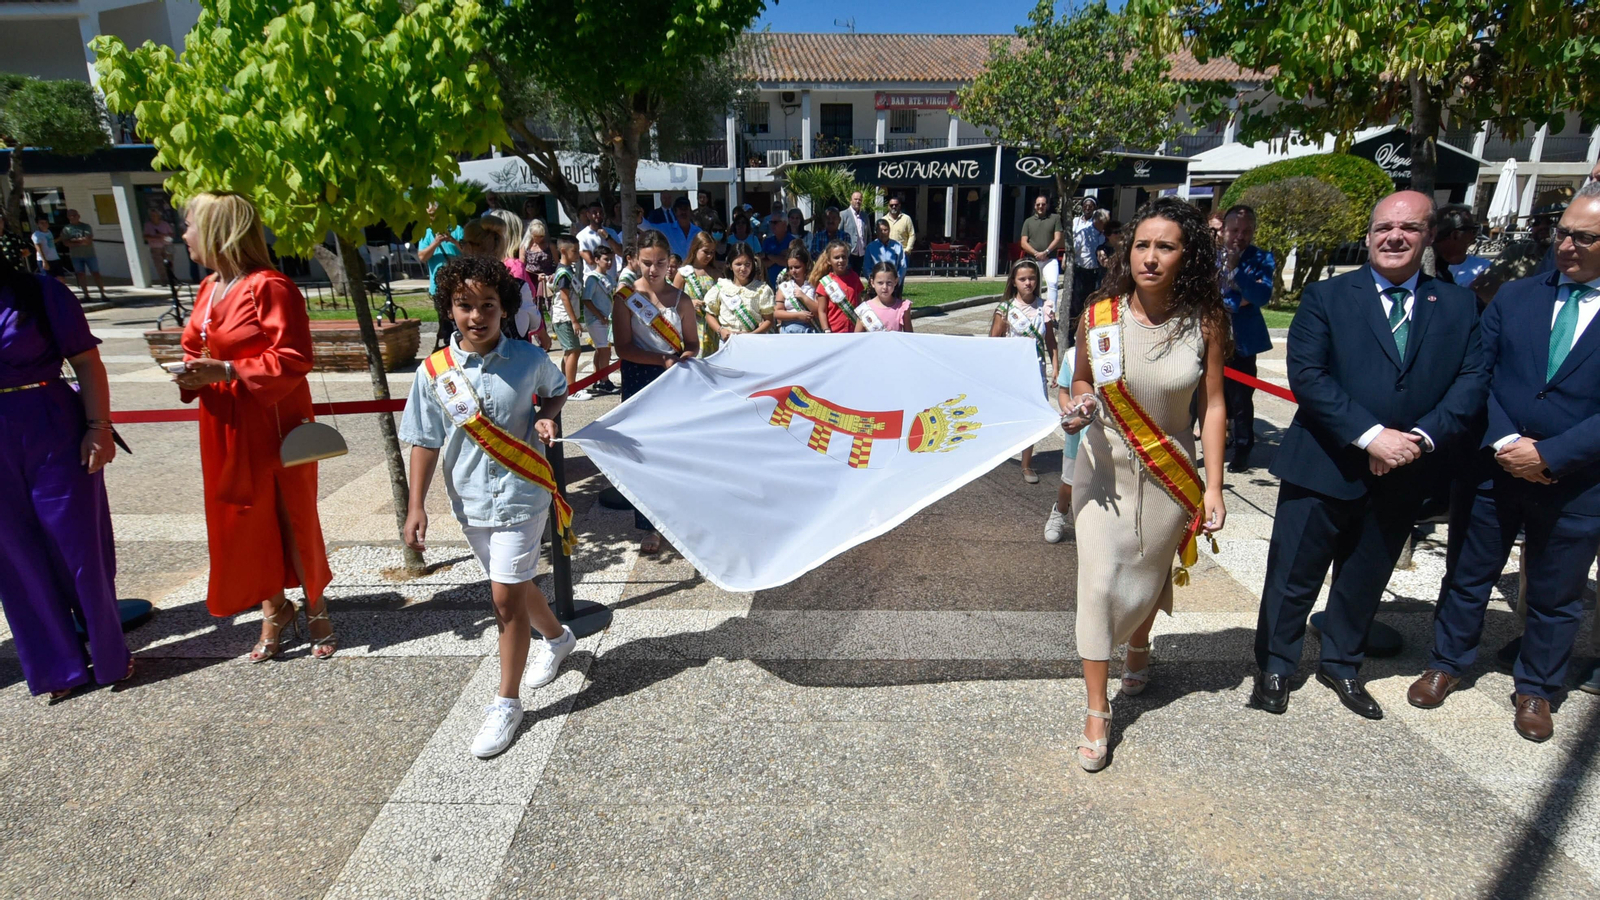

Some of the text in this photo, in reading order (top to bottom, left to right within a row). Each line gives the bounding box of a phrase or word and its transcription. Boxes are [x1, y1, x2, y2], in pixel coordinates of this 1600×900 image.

[891, 96, 905, 105] BAR
[925, 96, 948, 105] VIRGIL
[877, 160, 980, 179] RESTAURANTE
